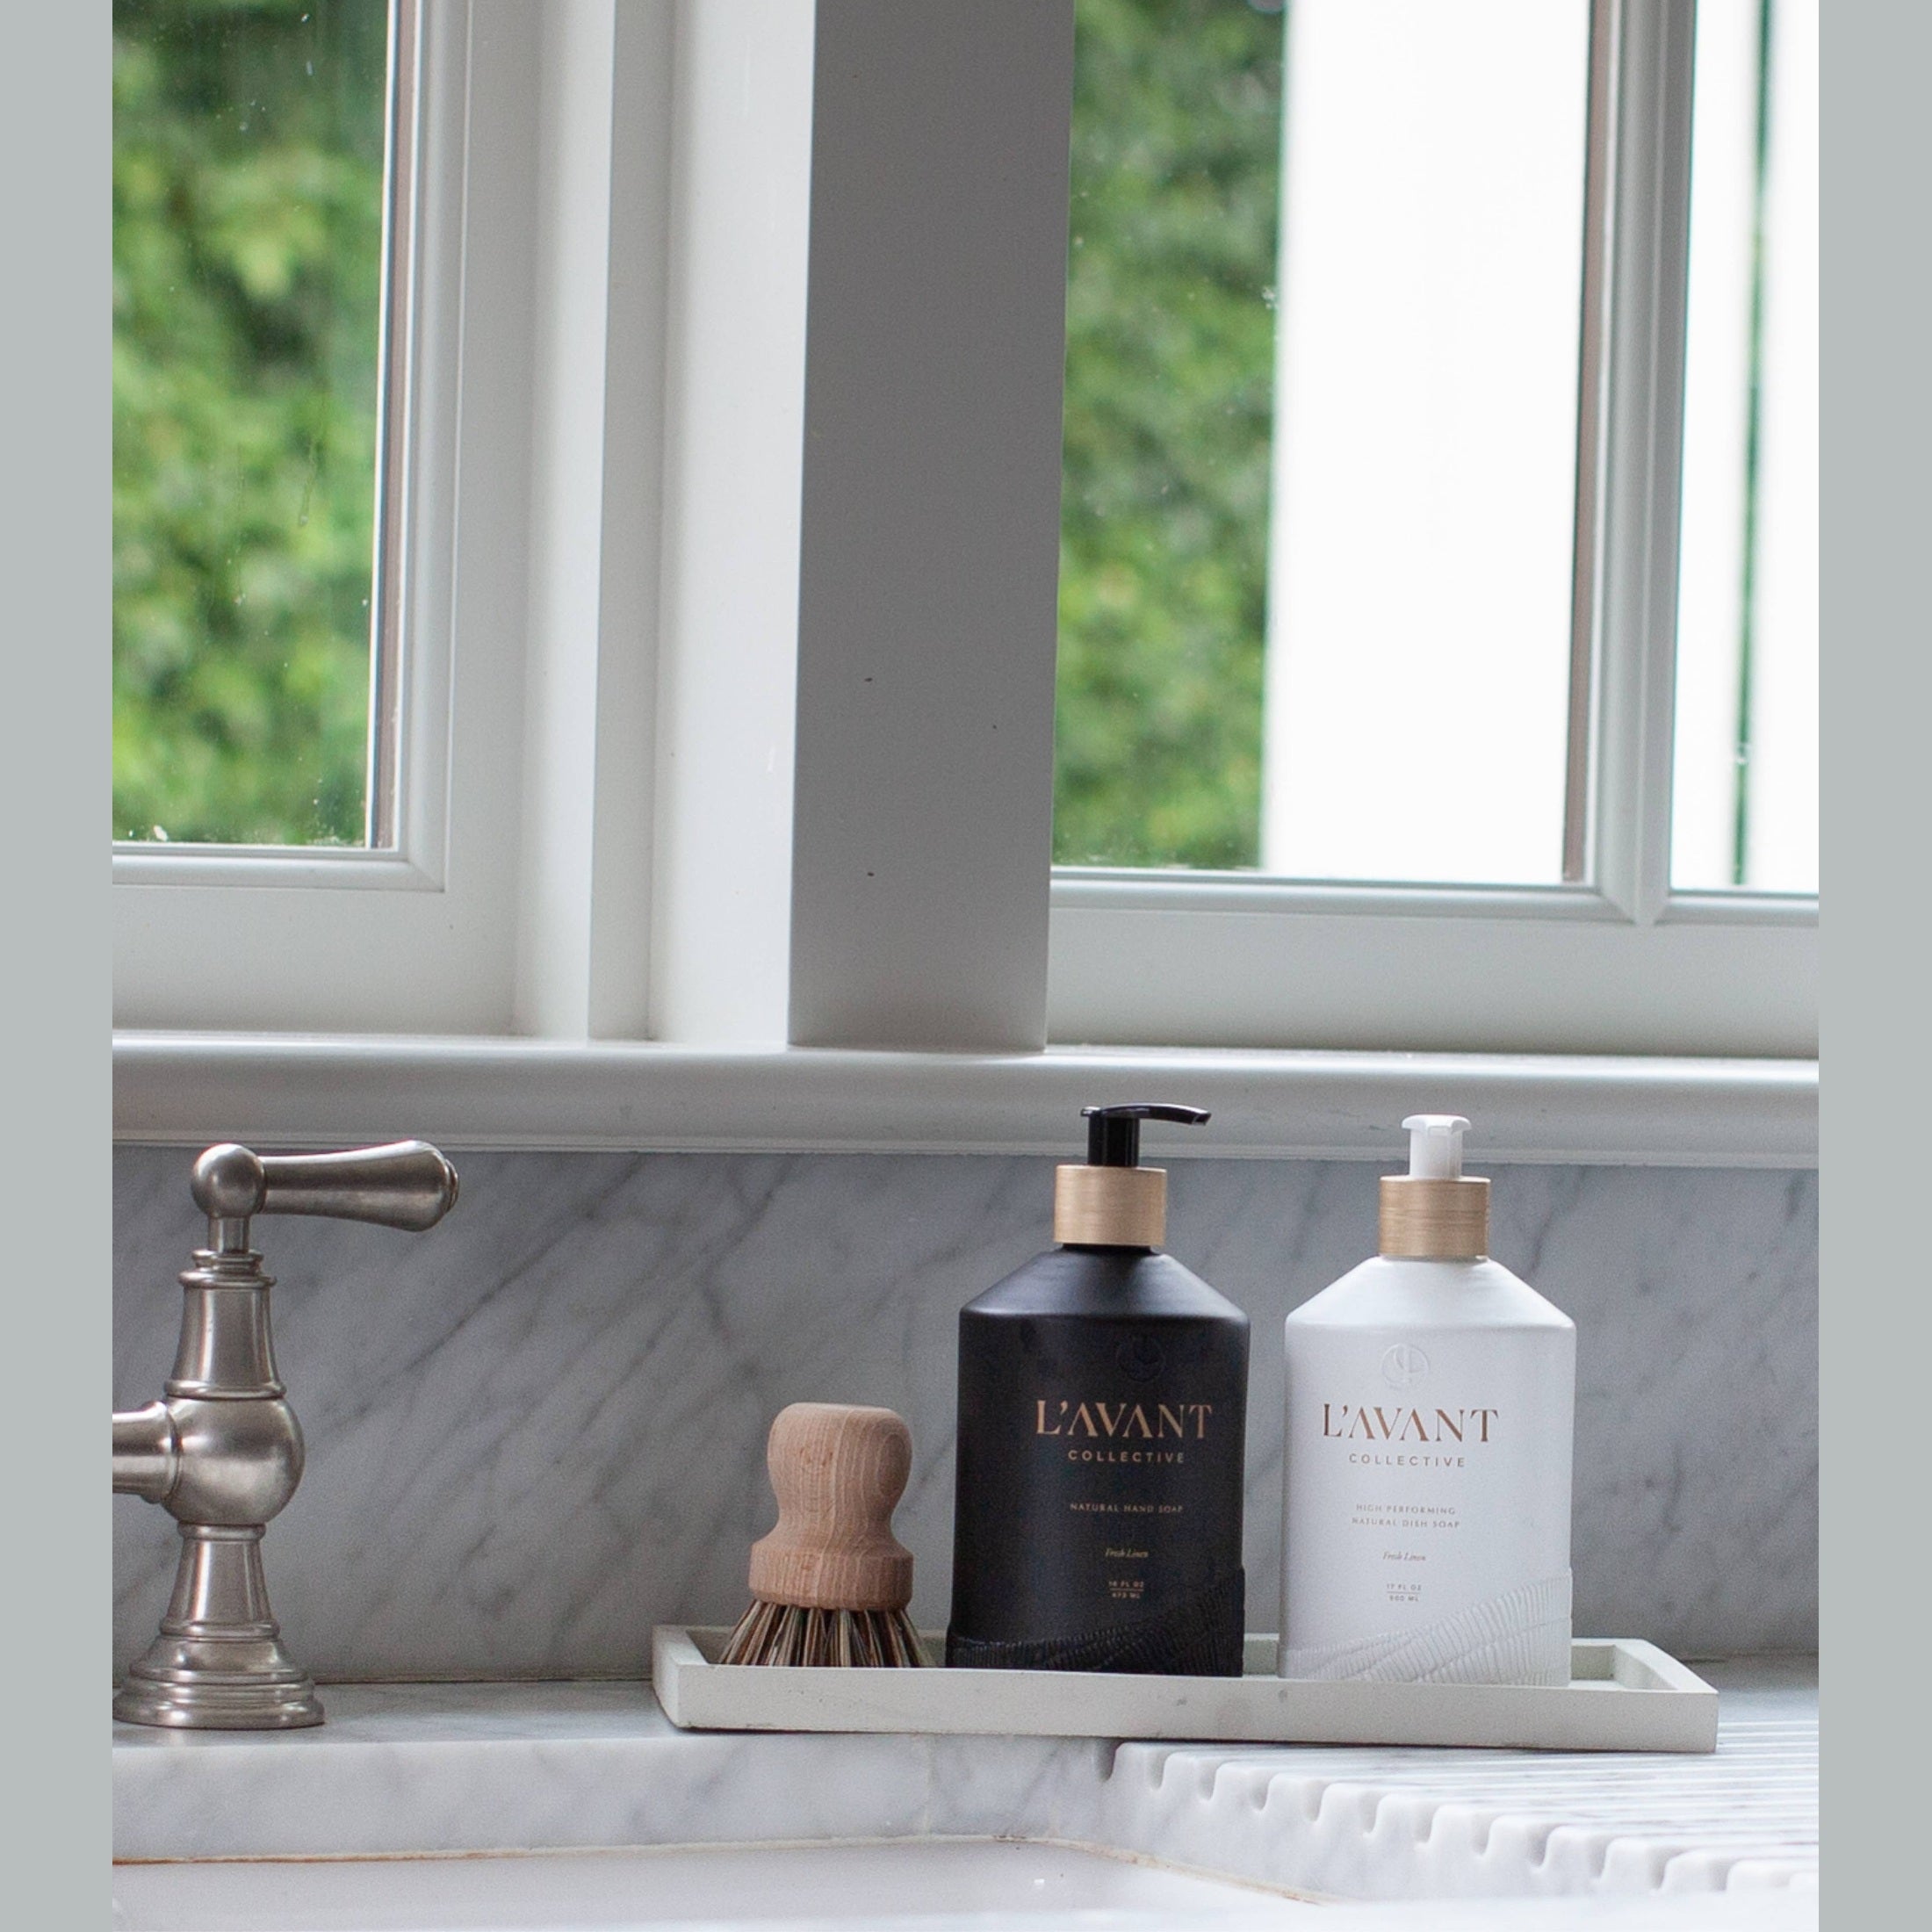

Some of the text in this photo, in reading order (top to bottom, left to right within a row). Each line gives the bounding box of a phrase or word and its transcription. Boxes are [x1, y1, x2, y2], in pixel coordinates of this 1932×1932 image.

[1036, 1400, 1213, 1438] L'AVANT
[1323, 1403, 1499, 1443] L'AVANT
[1068, 1450, 1185, 1464] COLLECTIVE
[1349, 1453, 1466, 1467] COLLECTIVE
[1070, 1503, 1184, 1513] NATURAL HAND SOAP
[1356, 1503, 1456, 1515] HIGH PERFORMING
[1352, 1517, 1397, 1525] NATURAL
[1402, 1519, 1428, 1528] DISH
